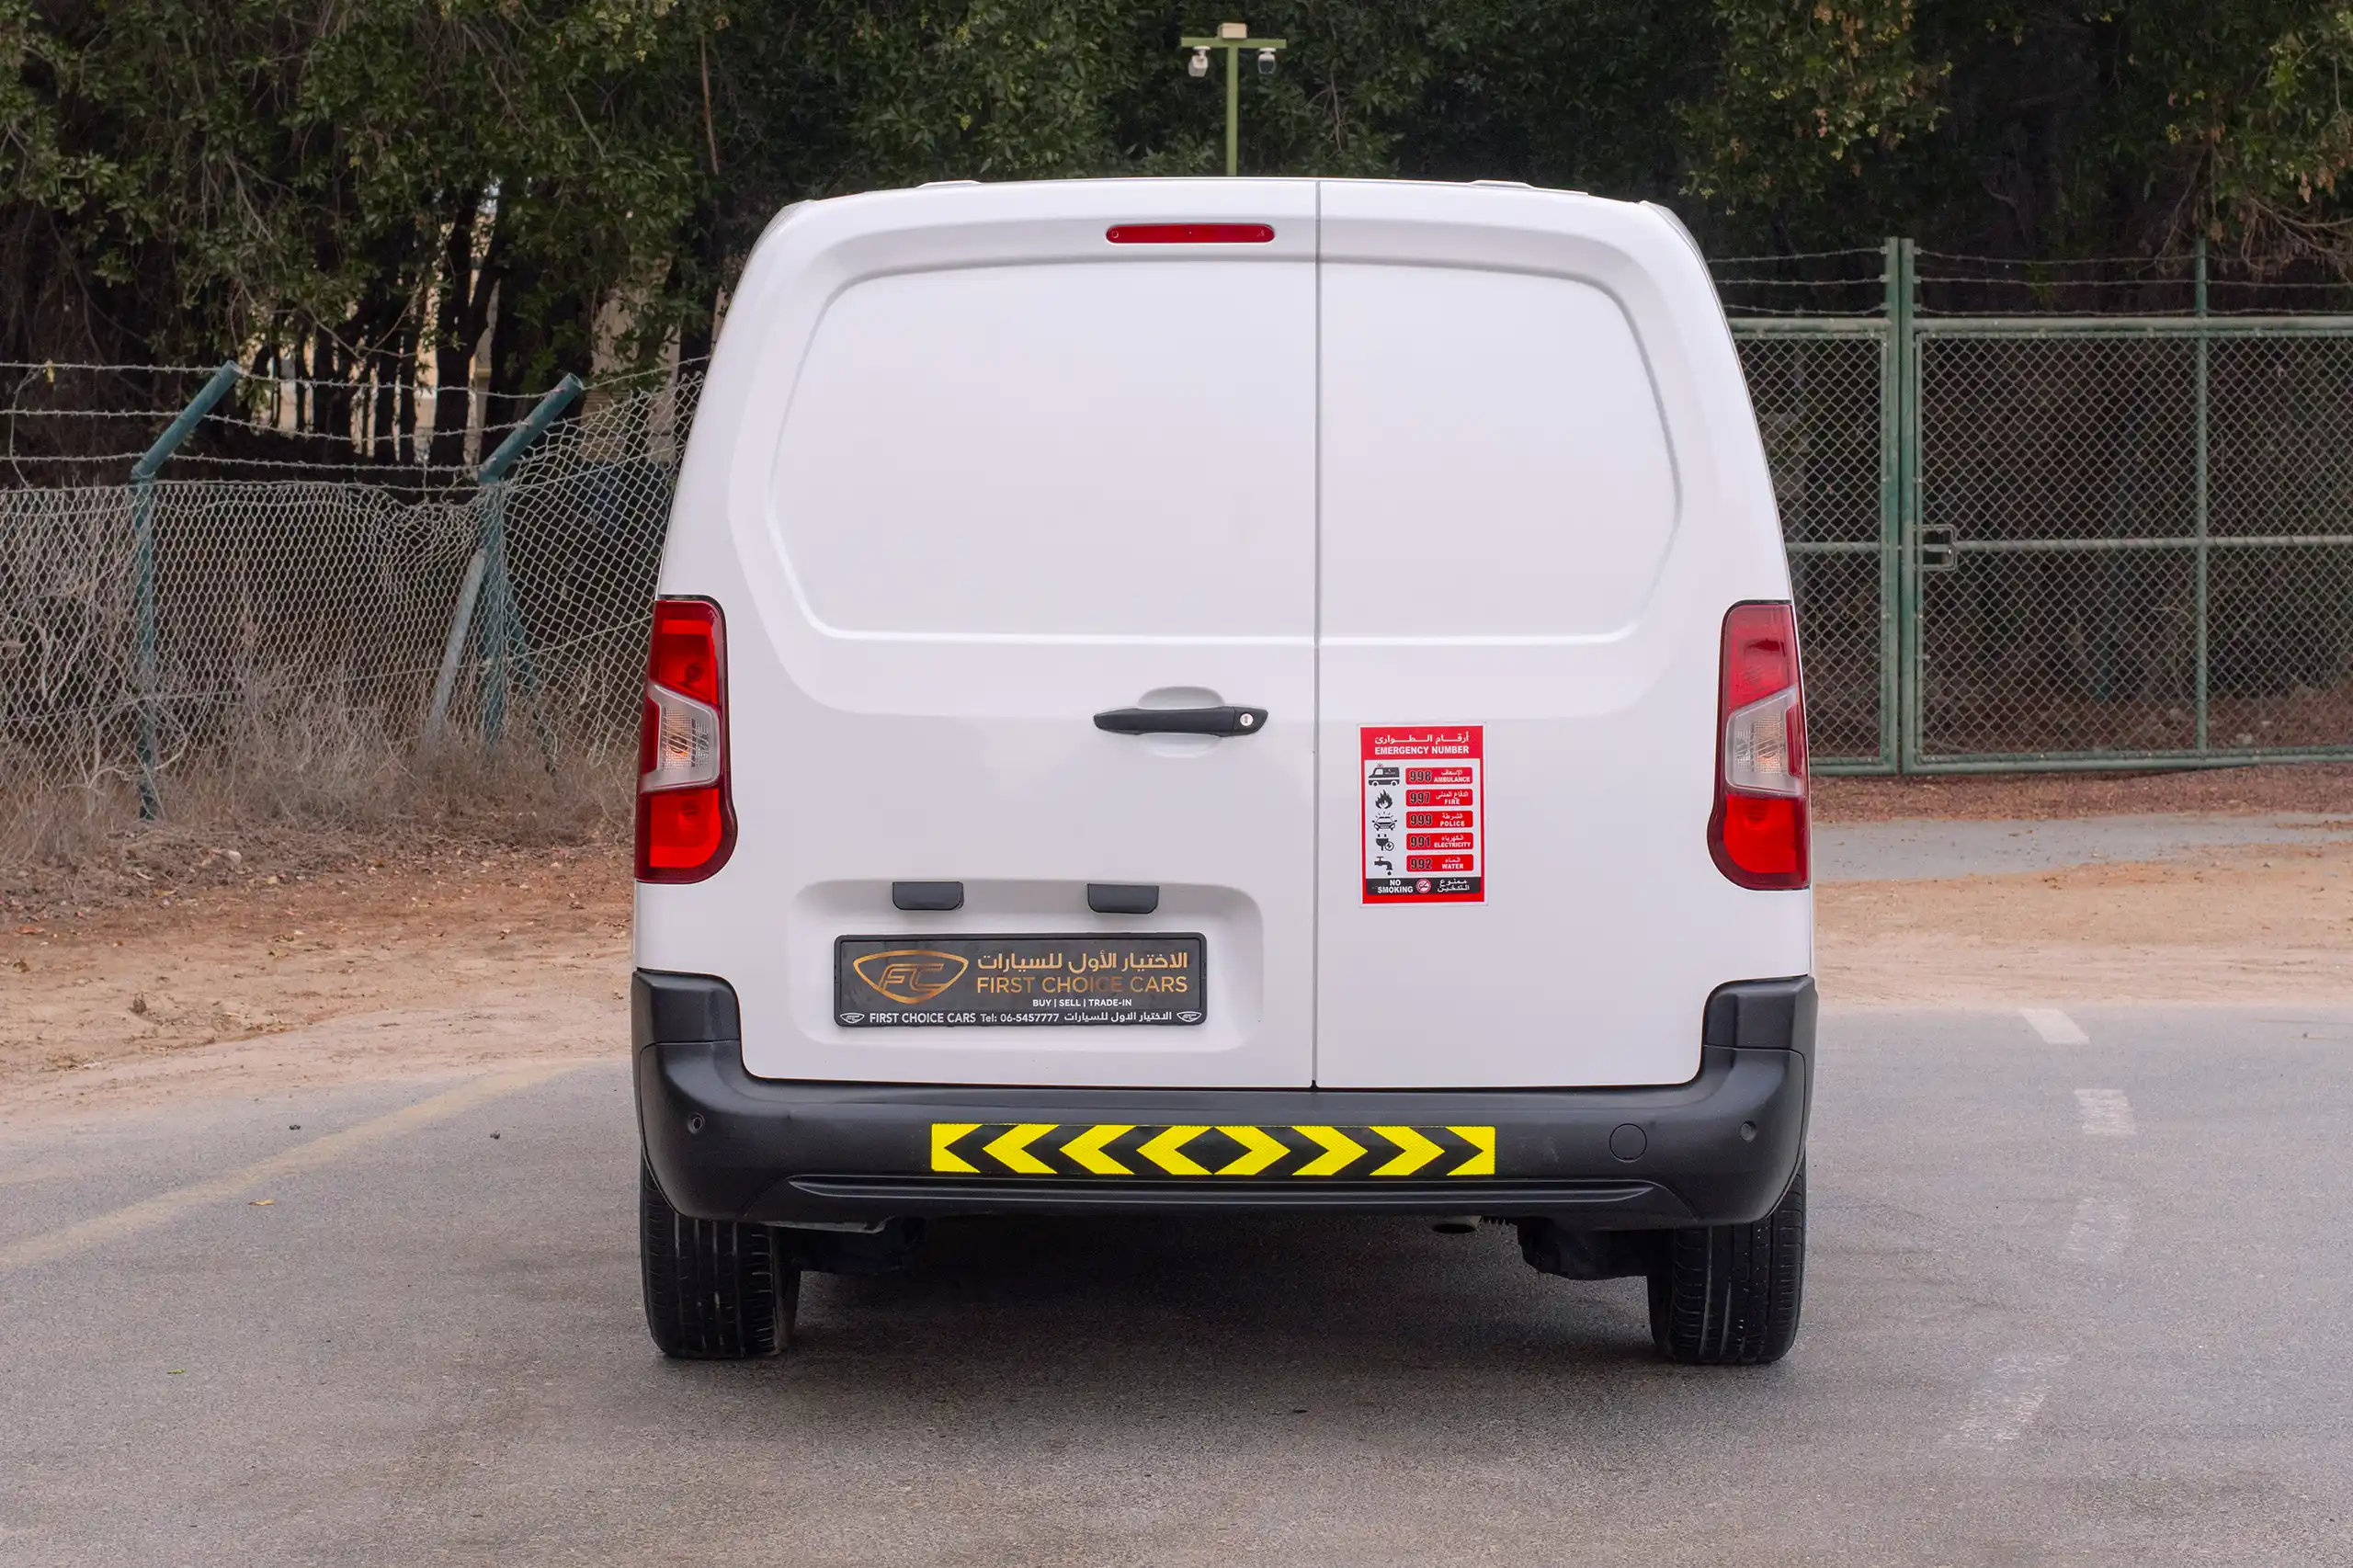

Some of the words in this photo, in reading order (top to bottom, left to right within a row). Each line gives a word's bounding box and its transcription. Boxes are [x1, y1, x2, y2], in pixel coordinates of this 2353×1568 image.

[1374, 745, 1429, 755] EMERGENCY
[1431, 745, 1470, 755] NUMBER
[1409, 770, 1431, 782] 998
[1410, 791, 1430, 804] 997
[1410, 813, 1433, 826] 999
[1410, 835, 1430, 848] 991
[1410, 858, 1433, 870] 992
[1377, 885, 1414, 894] SMOKING
[977, 952, 1063, 972] للسيارات
[1067, 949, 1118, 974] الأول
[1121, 952, 1188, 972] الاختيار
[977, 976, 1036, 994] FIRST
[1041, 976, 1124, 994] CHOICE
[1130, 975, 1188, 994] CARS
[1032, 998, 1052, 1008] BUY
[1059, 998, 1082, 1007] SELL
[1088, 998, 1132, 1007] TRADE-IN
[869, 1013, 899, 1024] FIRST
[901, 1012, 944, 1024] CHOICE
[948, 1012, 976, 1024] CARS
[980, 1013, 997, 1023] Tel:
[1000, 1013, 1060, 1023] 06-5457777
[1063, 1012, 1108, 1023] للسيارات
[1110, 1011, 1137, 1022] الاول
[1139, 1011, 1173, 1023] الاختيار
